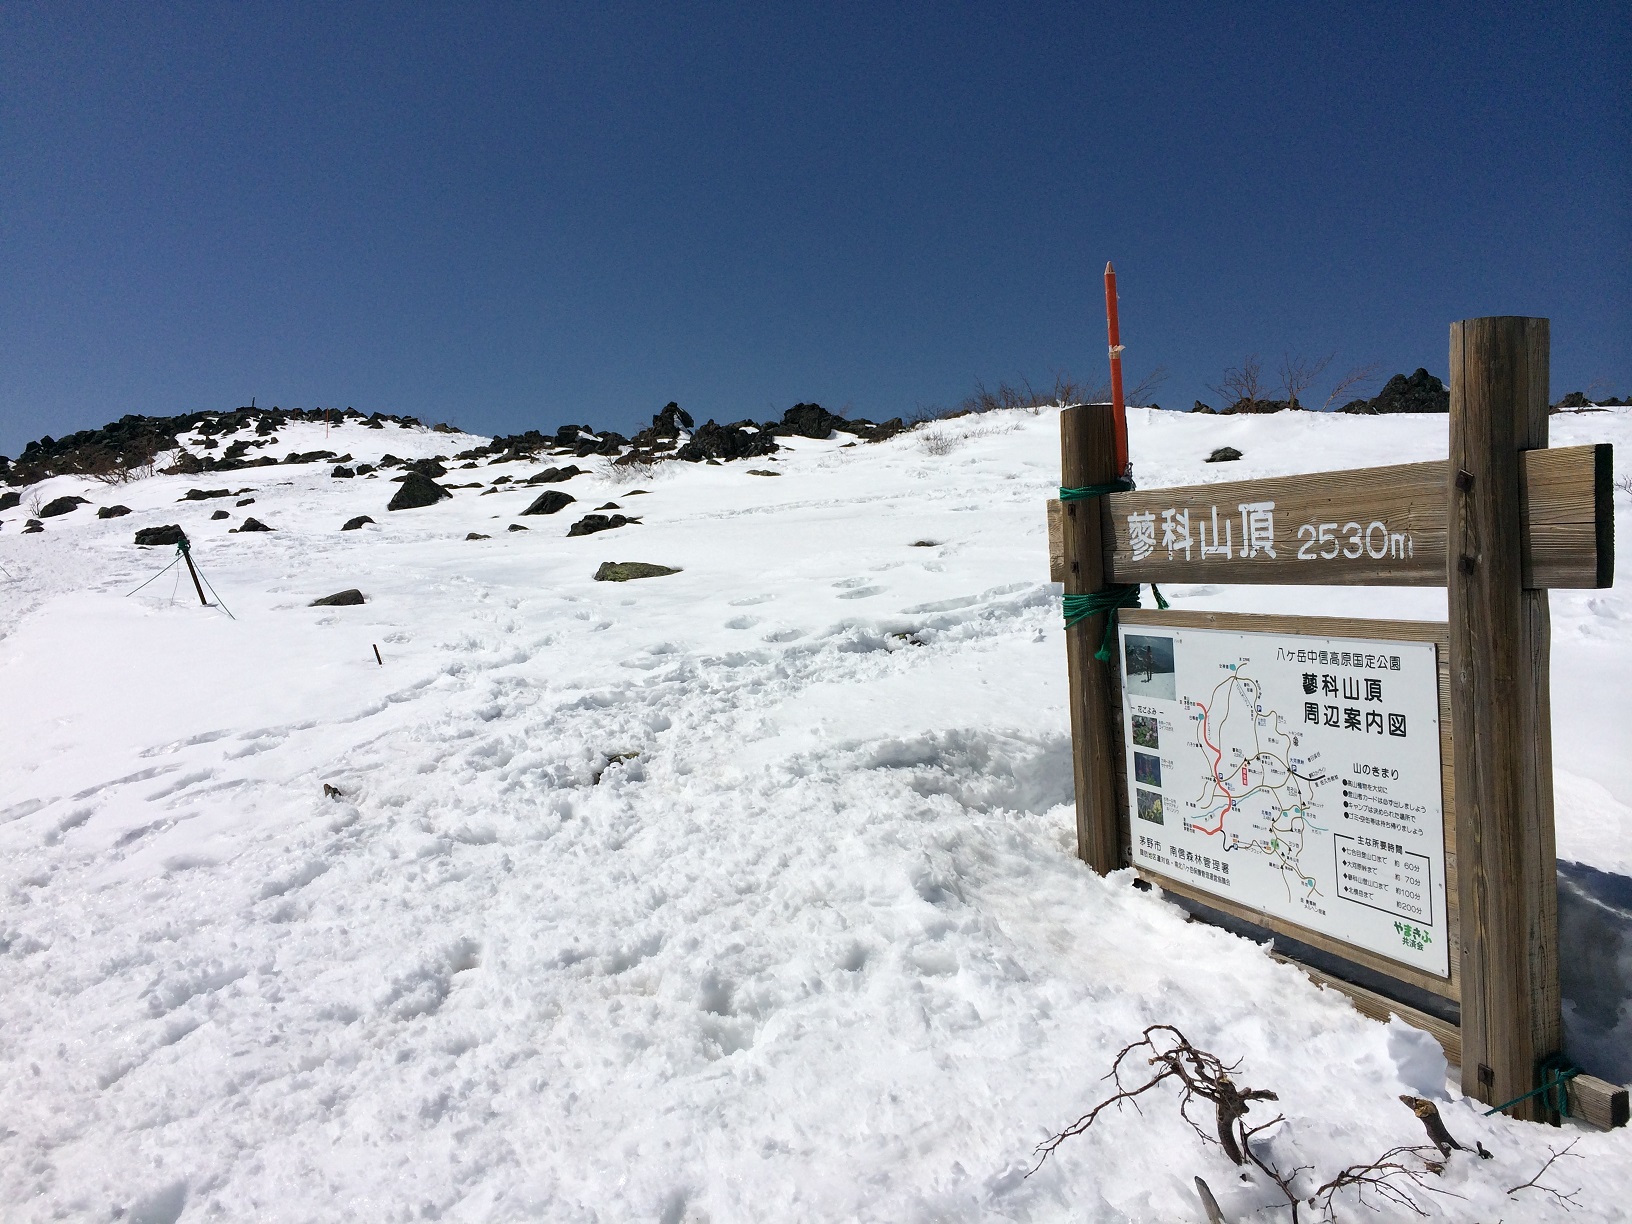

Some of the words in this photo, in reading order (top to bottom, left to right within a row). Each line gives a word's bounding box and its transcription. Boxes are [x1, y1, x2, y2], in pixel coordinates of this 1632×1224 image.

[1127, 500, 1277, 563] 蓼科山頂
[1296, 520, 1414, 562] 2530m
[1301, 671, 1383, 703] 蓼科山頂
[1303, 701, 1407, 738] 周辺案内図
[1352, 762, 1399, 781] 山のきまり
[1357, 835, 1403, 856] 主な所要時間
[1402, 936, 1424, 952] 共済会
